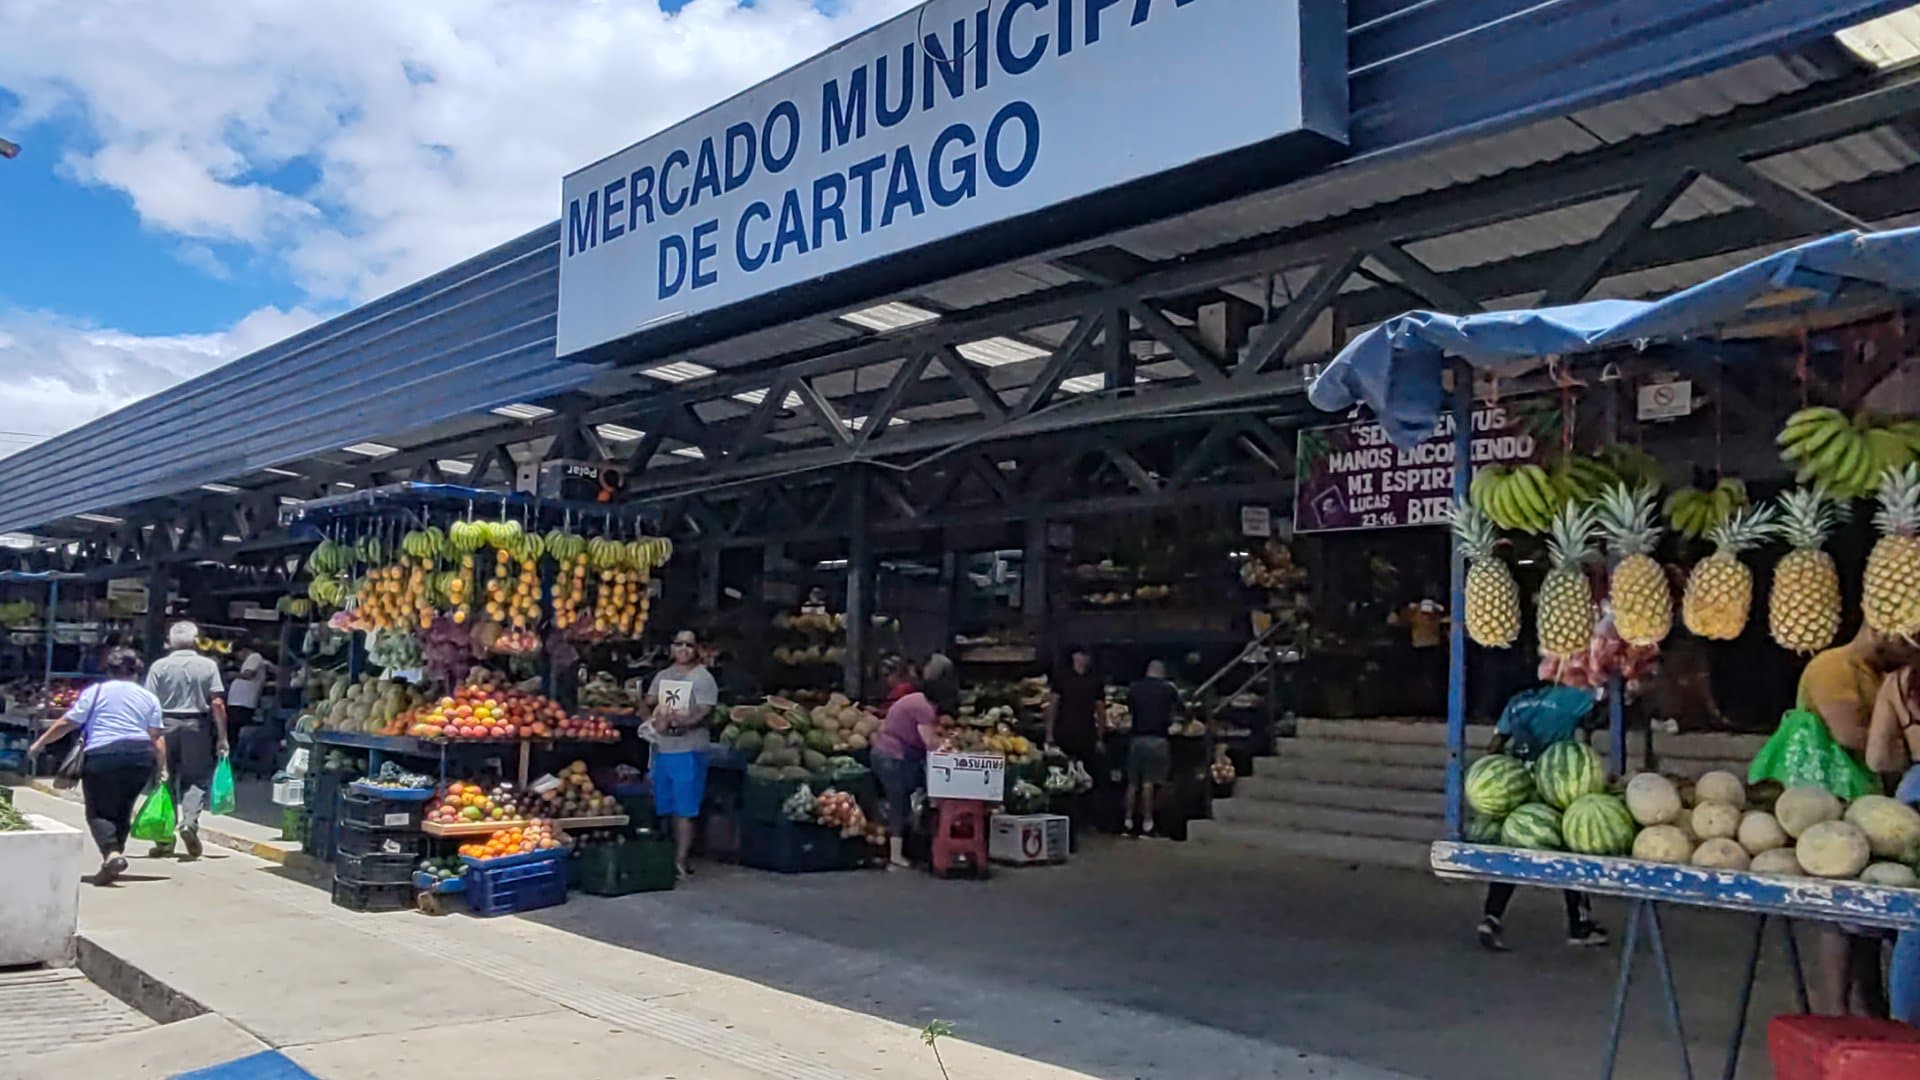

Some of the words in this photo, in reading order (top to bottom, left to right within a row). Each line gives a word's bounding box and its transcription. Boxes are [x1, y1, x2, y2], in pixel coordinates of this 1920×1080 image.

[568, 100, 800, 258] MERCADO
[821, 0, 1196, 153] MUNICIP
[658, 219, 719, 300] DE
[736, 100, 1040, 272] CARTAGO
[1328, 447, 1393, 474] MANOS
[1397, 435, 1535, 466] ENCOIENDO
[567, 465, 597, 478] Polar
[1347, 473, 1373, 496] MI
[1349, 494, 1391, 513] LUCAS
